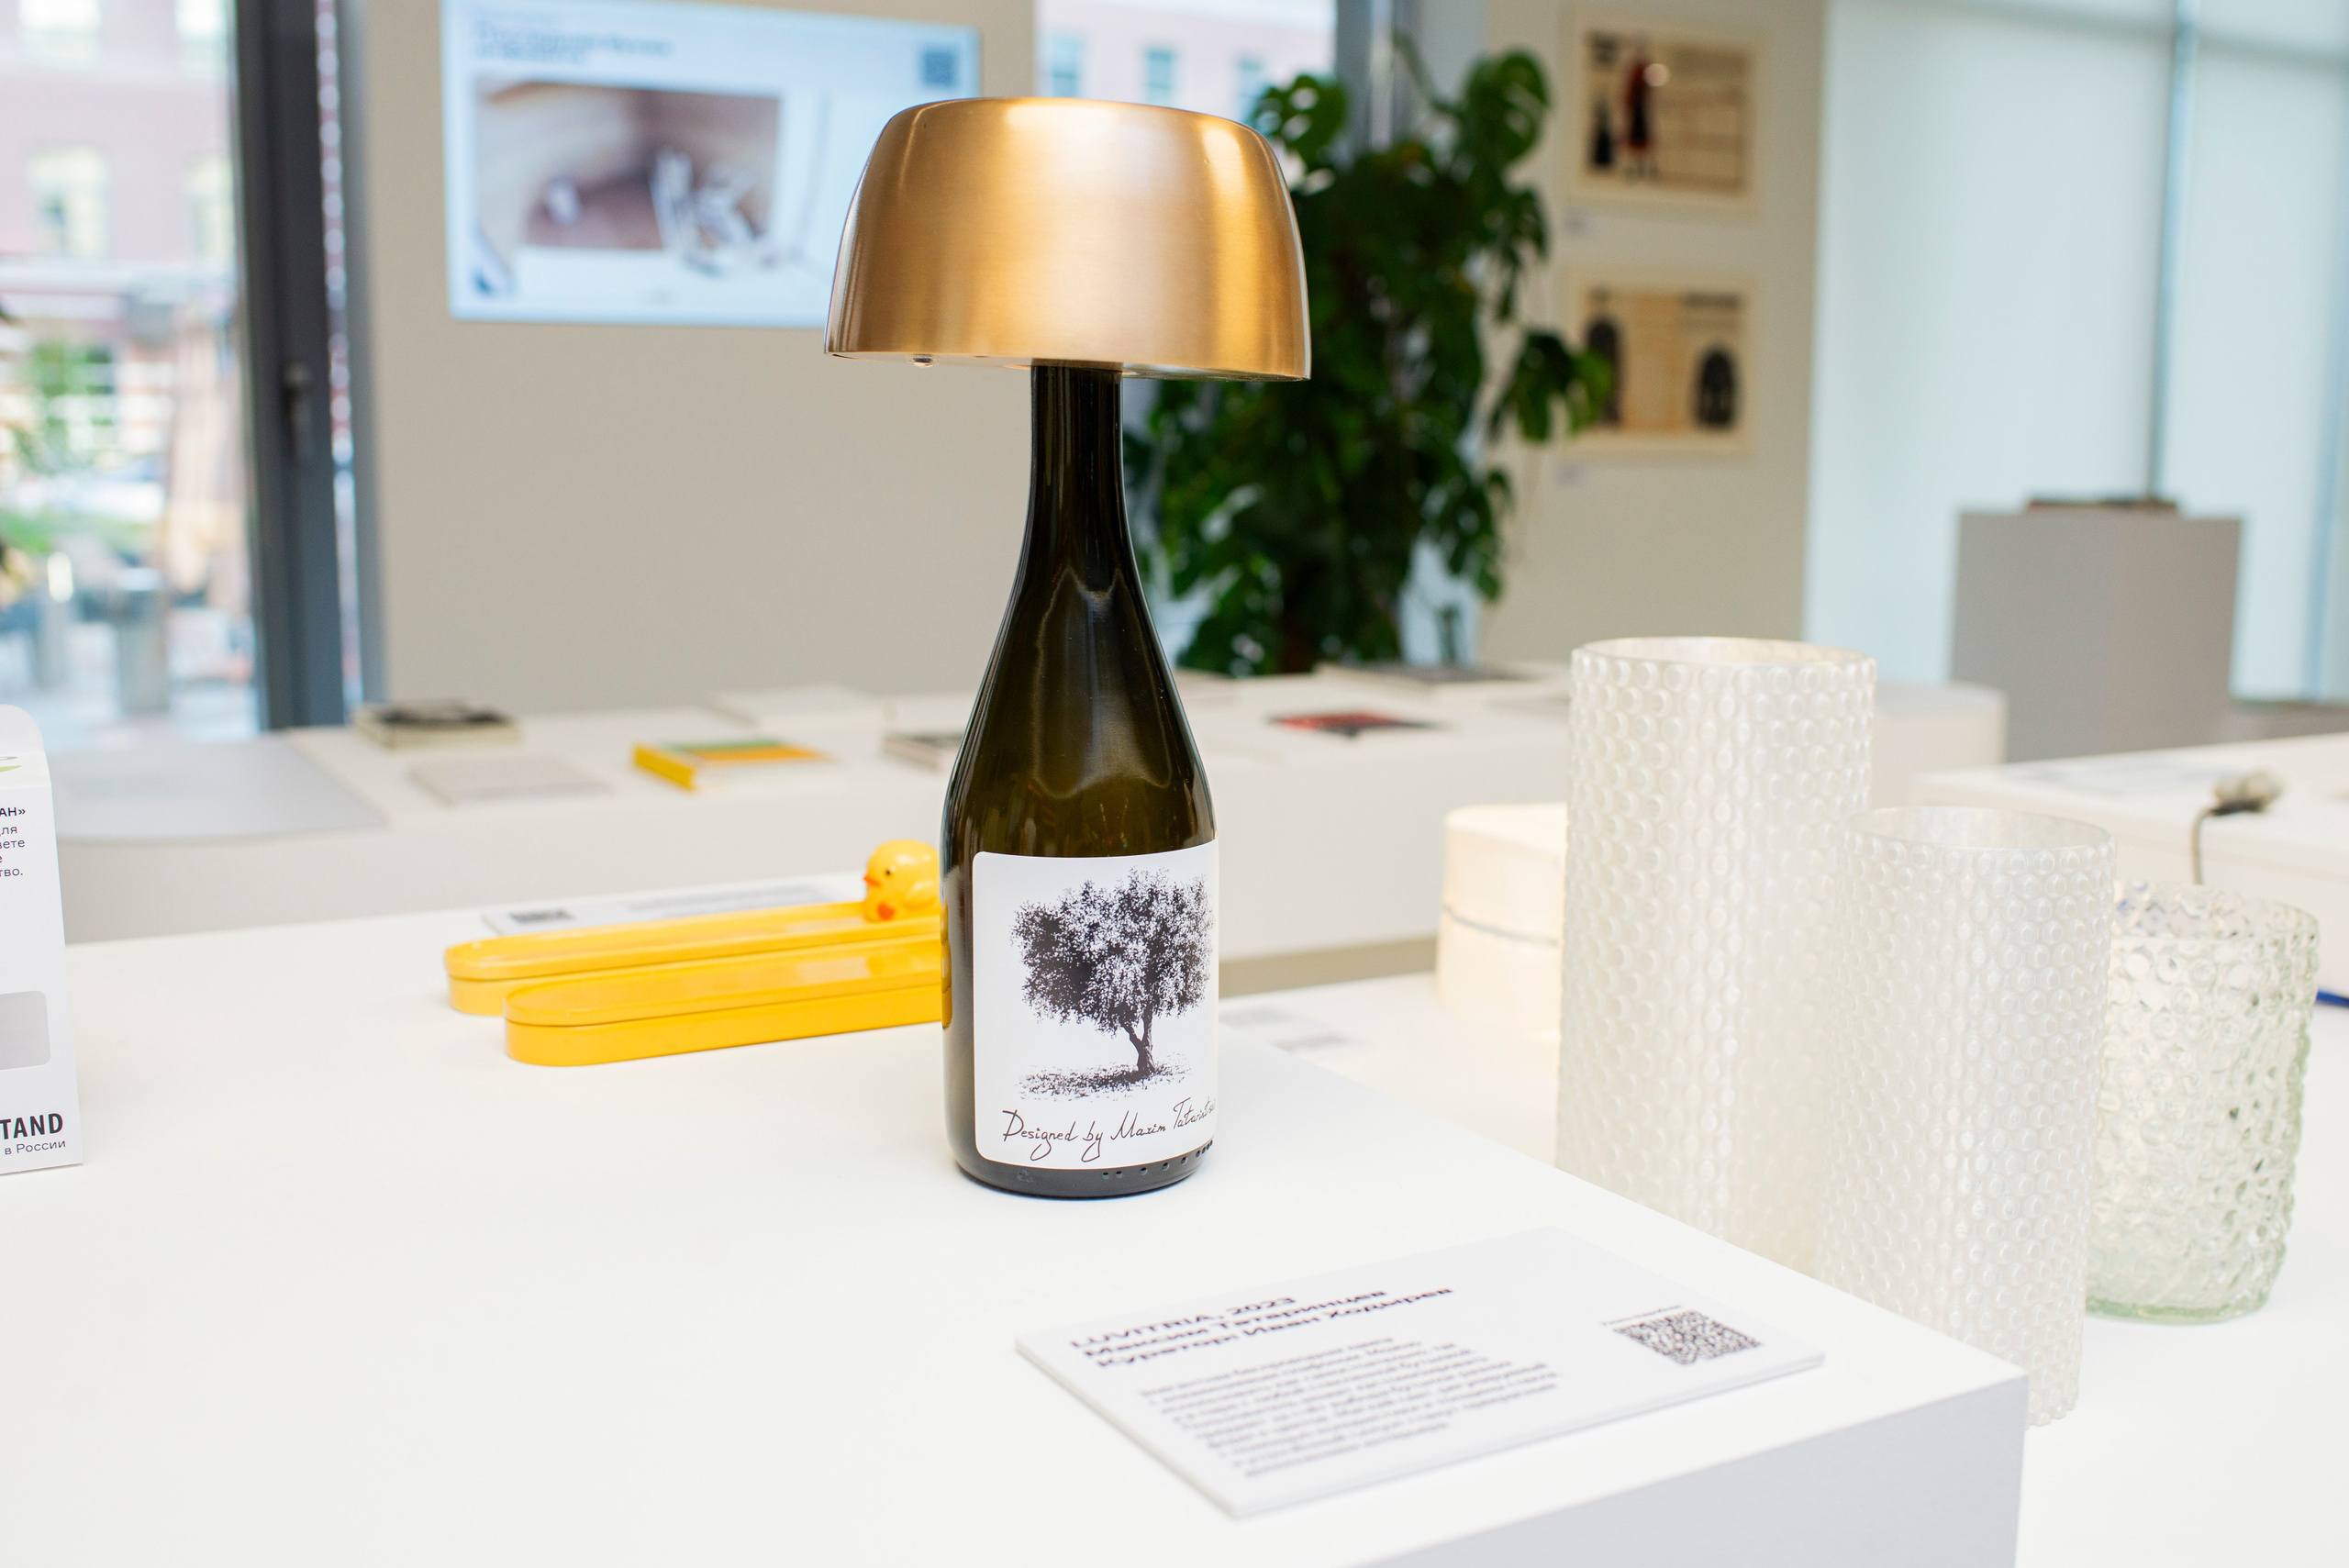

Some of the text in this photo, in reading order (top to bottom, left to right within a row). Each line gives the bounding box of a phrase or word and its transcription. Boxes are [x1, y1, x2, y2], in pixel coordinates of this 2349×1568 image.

[0, 826, 17, 837] ля
[0, 840, 26, 849] ете
[1002, 1109, 1079, 1162] Designed
[1081, 1120, 1104, 1162] by
[1110, 1110, 1166, 1140] Maxim
[5, 1140, 66, 1155] в России
[1227, 1296, 1296, 1315] 2023
[1242, 1316, 1320, 1336] Иван
[1322, 1287, 1453, 1319] Ходырев
[1085, 1290, 1387, 1357] Максим Татаринцев
